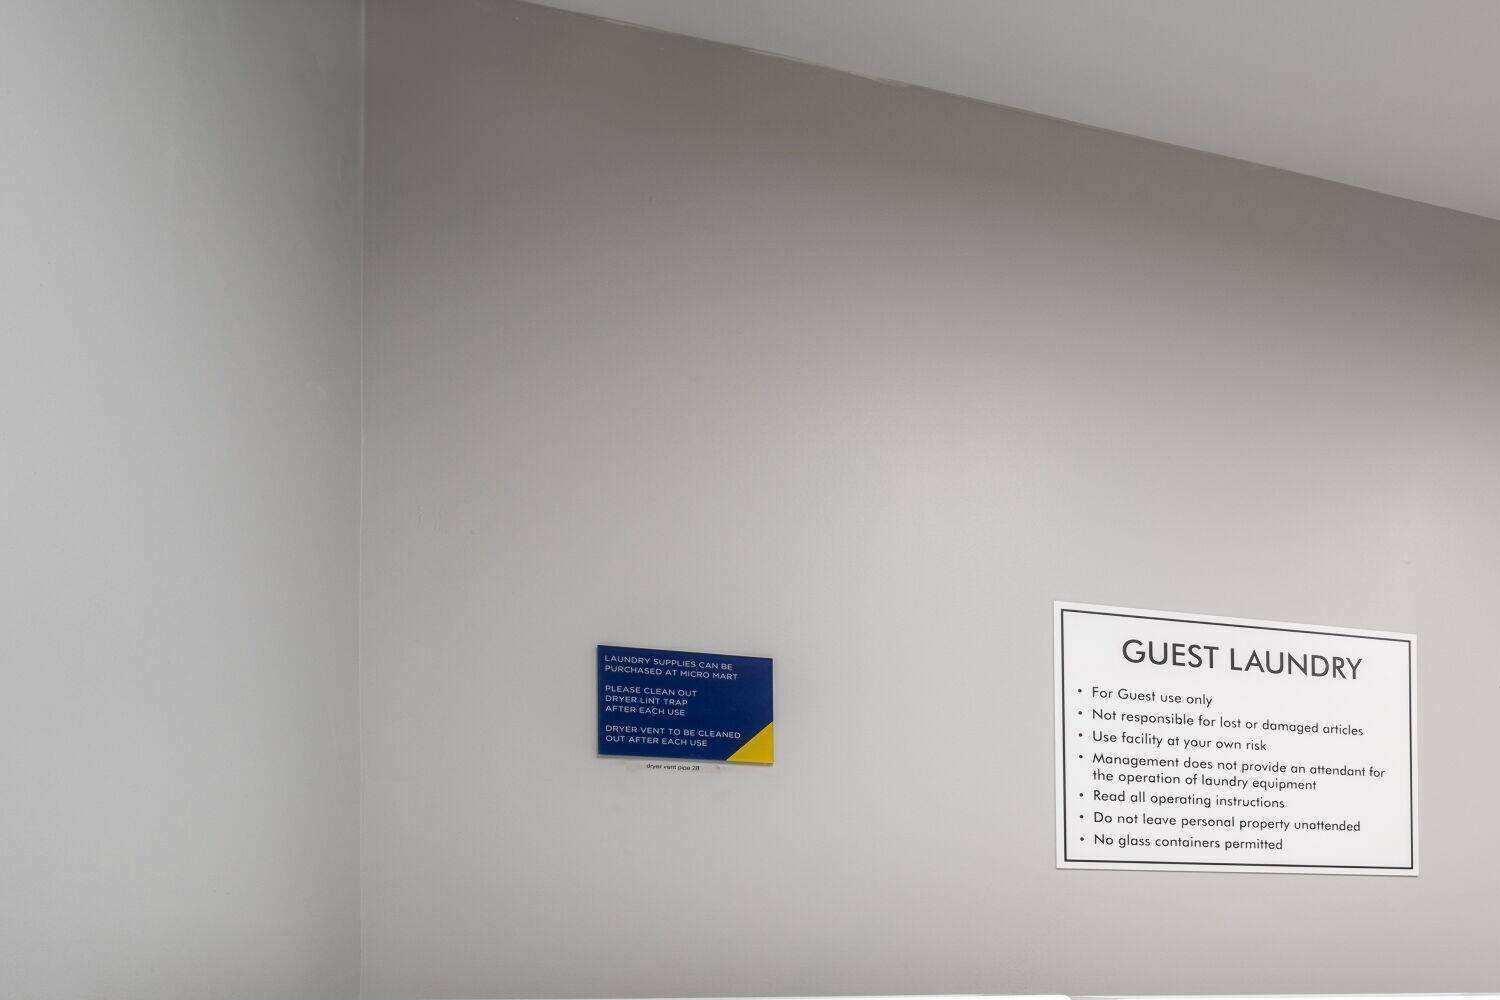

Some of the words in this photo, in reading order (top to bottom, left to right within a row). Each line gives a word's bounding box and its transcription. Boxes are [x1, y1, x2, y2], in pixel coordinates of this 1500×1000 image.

[604, 655, 650, 664] LAUNDRY
[653, 658, 696, 667] SUPPLIES
[1122, 639, 1219, 668] GUEST
[1230, 648, 1362, 680] LAUNDRY
[604, 665, 662, 675] PURCHASED
[680, 670, 710, 679] MICRO
[712, 672, 738, 680] MART
[605, 685, 641, 694] PLEASE
[644, 687, 675, 695] CLEAN
[678, 689, 697, 697] OUT
[1092, 686, 1113, 700] For
[1118, 688, 1156, 702] Guest
[1160, 693, 1181, 704] use
[1186, 693, 1213, 707] only
[605, 705, 637, 713] AFTER
[639, 707, 665, 715] EACH
[605, 725, 637, 733] DRYER
[641, 727, 666, 735] VENT
[698, 730, 741, 739] CLEANED
[1092, 709, 1117, 721] Not
[1121, 710, 1194, 726] responsible
[1198, 715, 1216, 727] for
[1220, 716, 1241, 728] lost
[1245, 719, 1258, 729] or
[1262, 718, 1318, 735] damaged
[1323, 722, 1364, 737] articles
[605, 735, 625, 743] OUT
[629, 736, 658, 744] AFTER
[1093, 731, 1117, 744] Use
[1122, 732, 1163, 747] facility
[1167, 736, 1179, 746] at
[1184, 738, 1212, 750] your
[1216, 738, 1241, 750] own
[1246, 738, 1268, 751] risk
[1093, 753, 1179, 770] Management
[1183, 756, 1213, 770] does
[1217, 759, 1237, 771] not
[1241, 761, 1286, 775] provide
[1290, 763, 1305, 774] an
[1310, 763, 1365, 777] attendant
[1369, 766, 1386, 778] for
[1093, 769, 1114, 782] the
[1118, 771, 1181, 786] operation
[1185, 772, 1197, 785] of
[1201, 774, 1248, 789] laundry
[1252, 776, 1317, 791] equipment
[1093, 790, 1125, 802] Read
[1131, 791, 1146, 804] all
[1150, 792, 1212, 808] operating
[1216, 795, 1285, 808] instructions
[1093, 812, 1112, 824] Do
[1117, 813, 1138, 824] not
[1143, 814, 1176, 826] leave
[1181, 815, 1235, 829] personal
[1239, 817, 1289, 832] property
[1294, 819, 1361, 832] unattended
[1094, 834, 1114, 846] No
[1118, 835, 1150, 848] glass
[1155, 836, 1220, 849] containers
[1225, 838, 1283, 851] permitted
